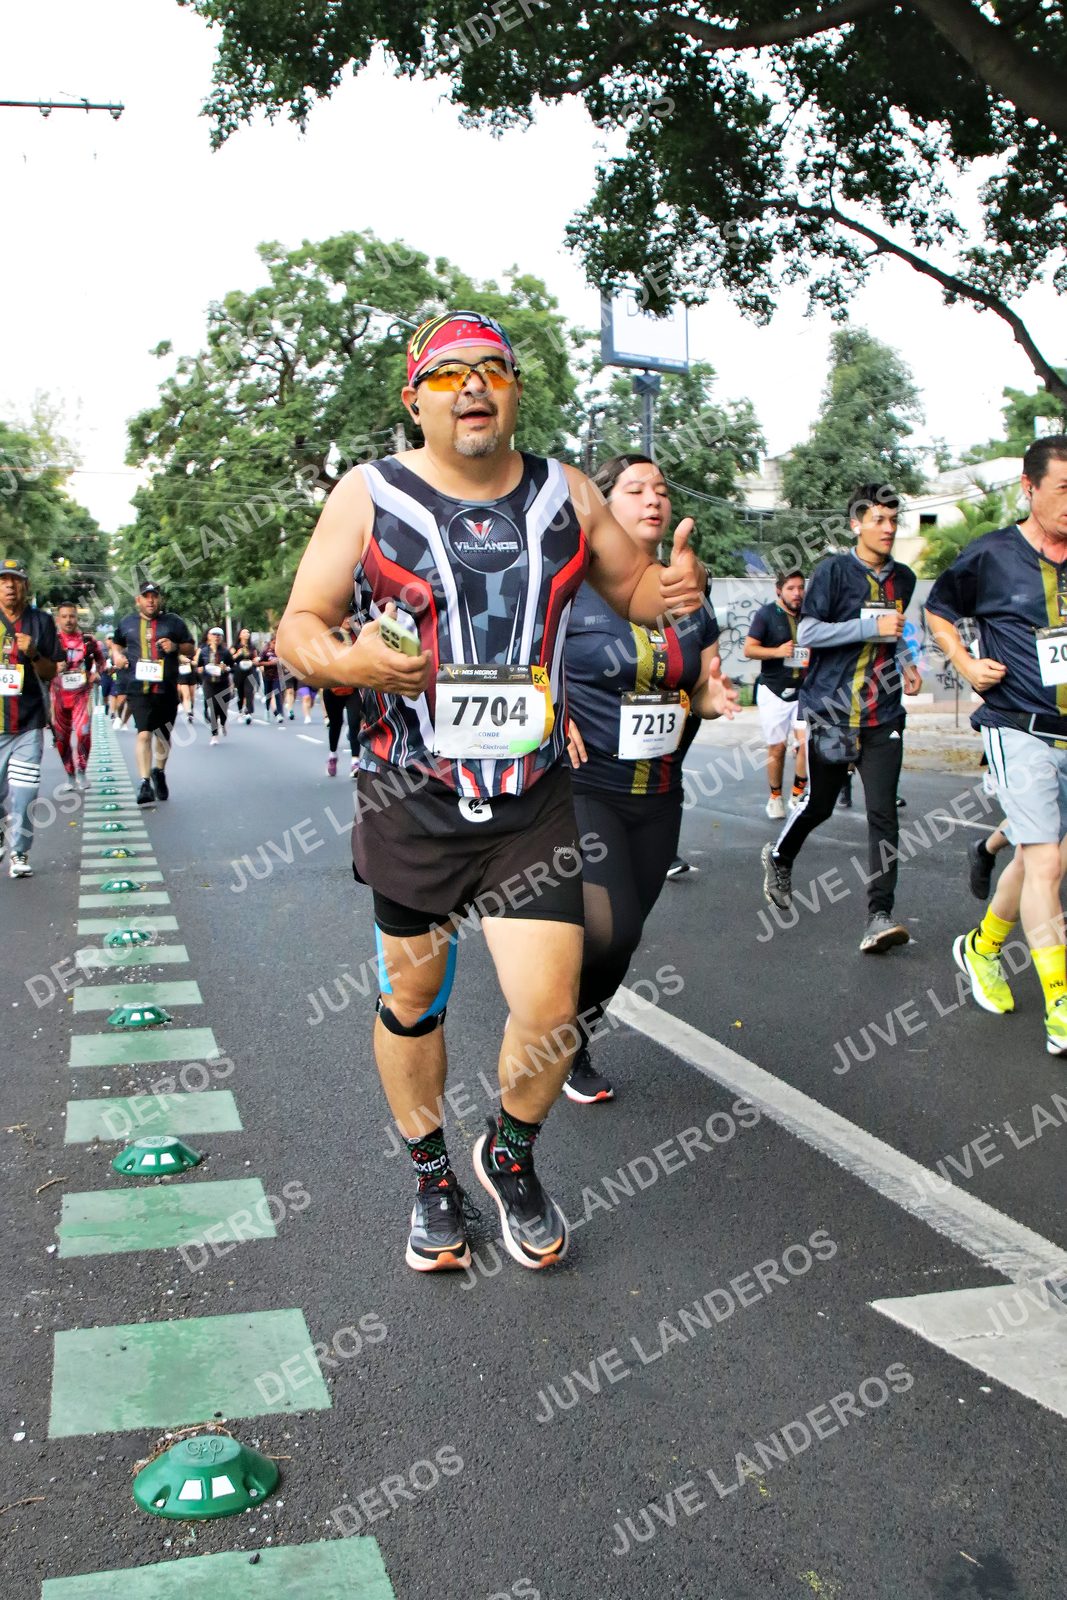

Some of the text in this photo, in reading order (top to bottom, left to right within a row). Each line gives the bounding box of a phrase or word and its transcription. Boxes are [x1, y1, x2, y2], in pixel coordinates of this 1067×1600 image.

[454, 541, 519, 551] VILLANOS
[533, 672, 545, 685] 5K
[451, 696, 529, 727] 7704
[631, 712, 676, 736] 7213
